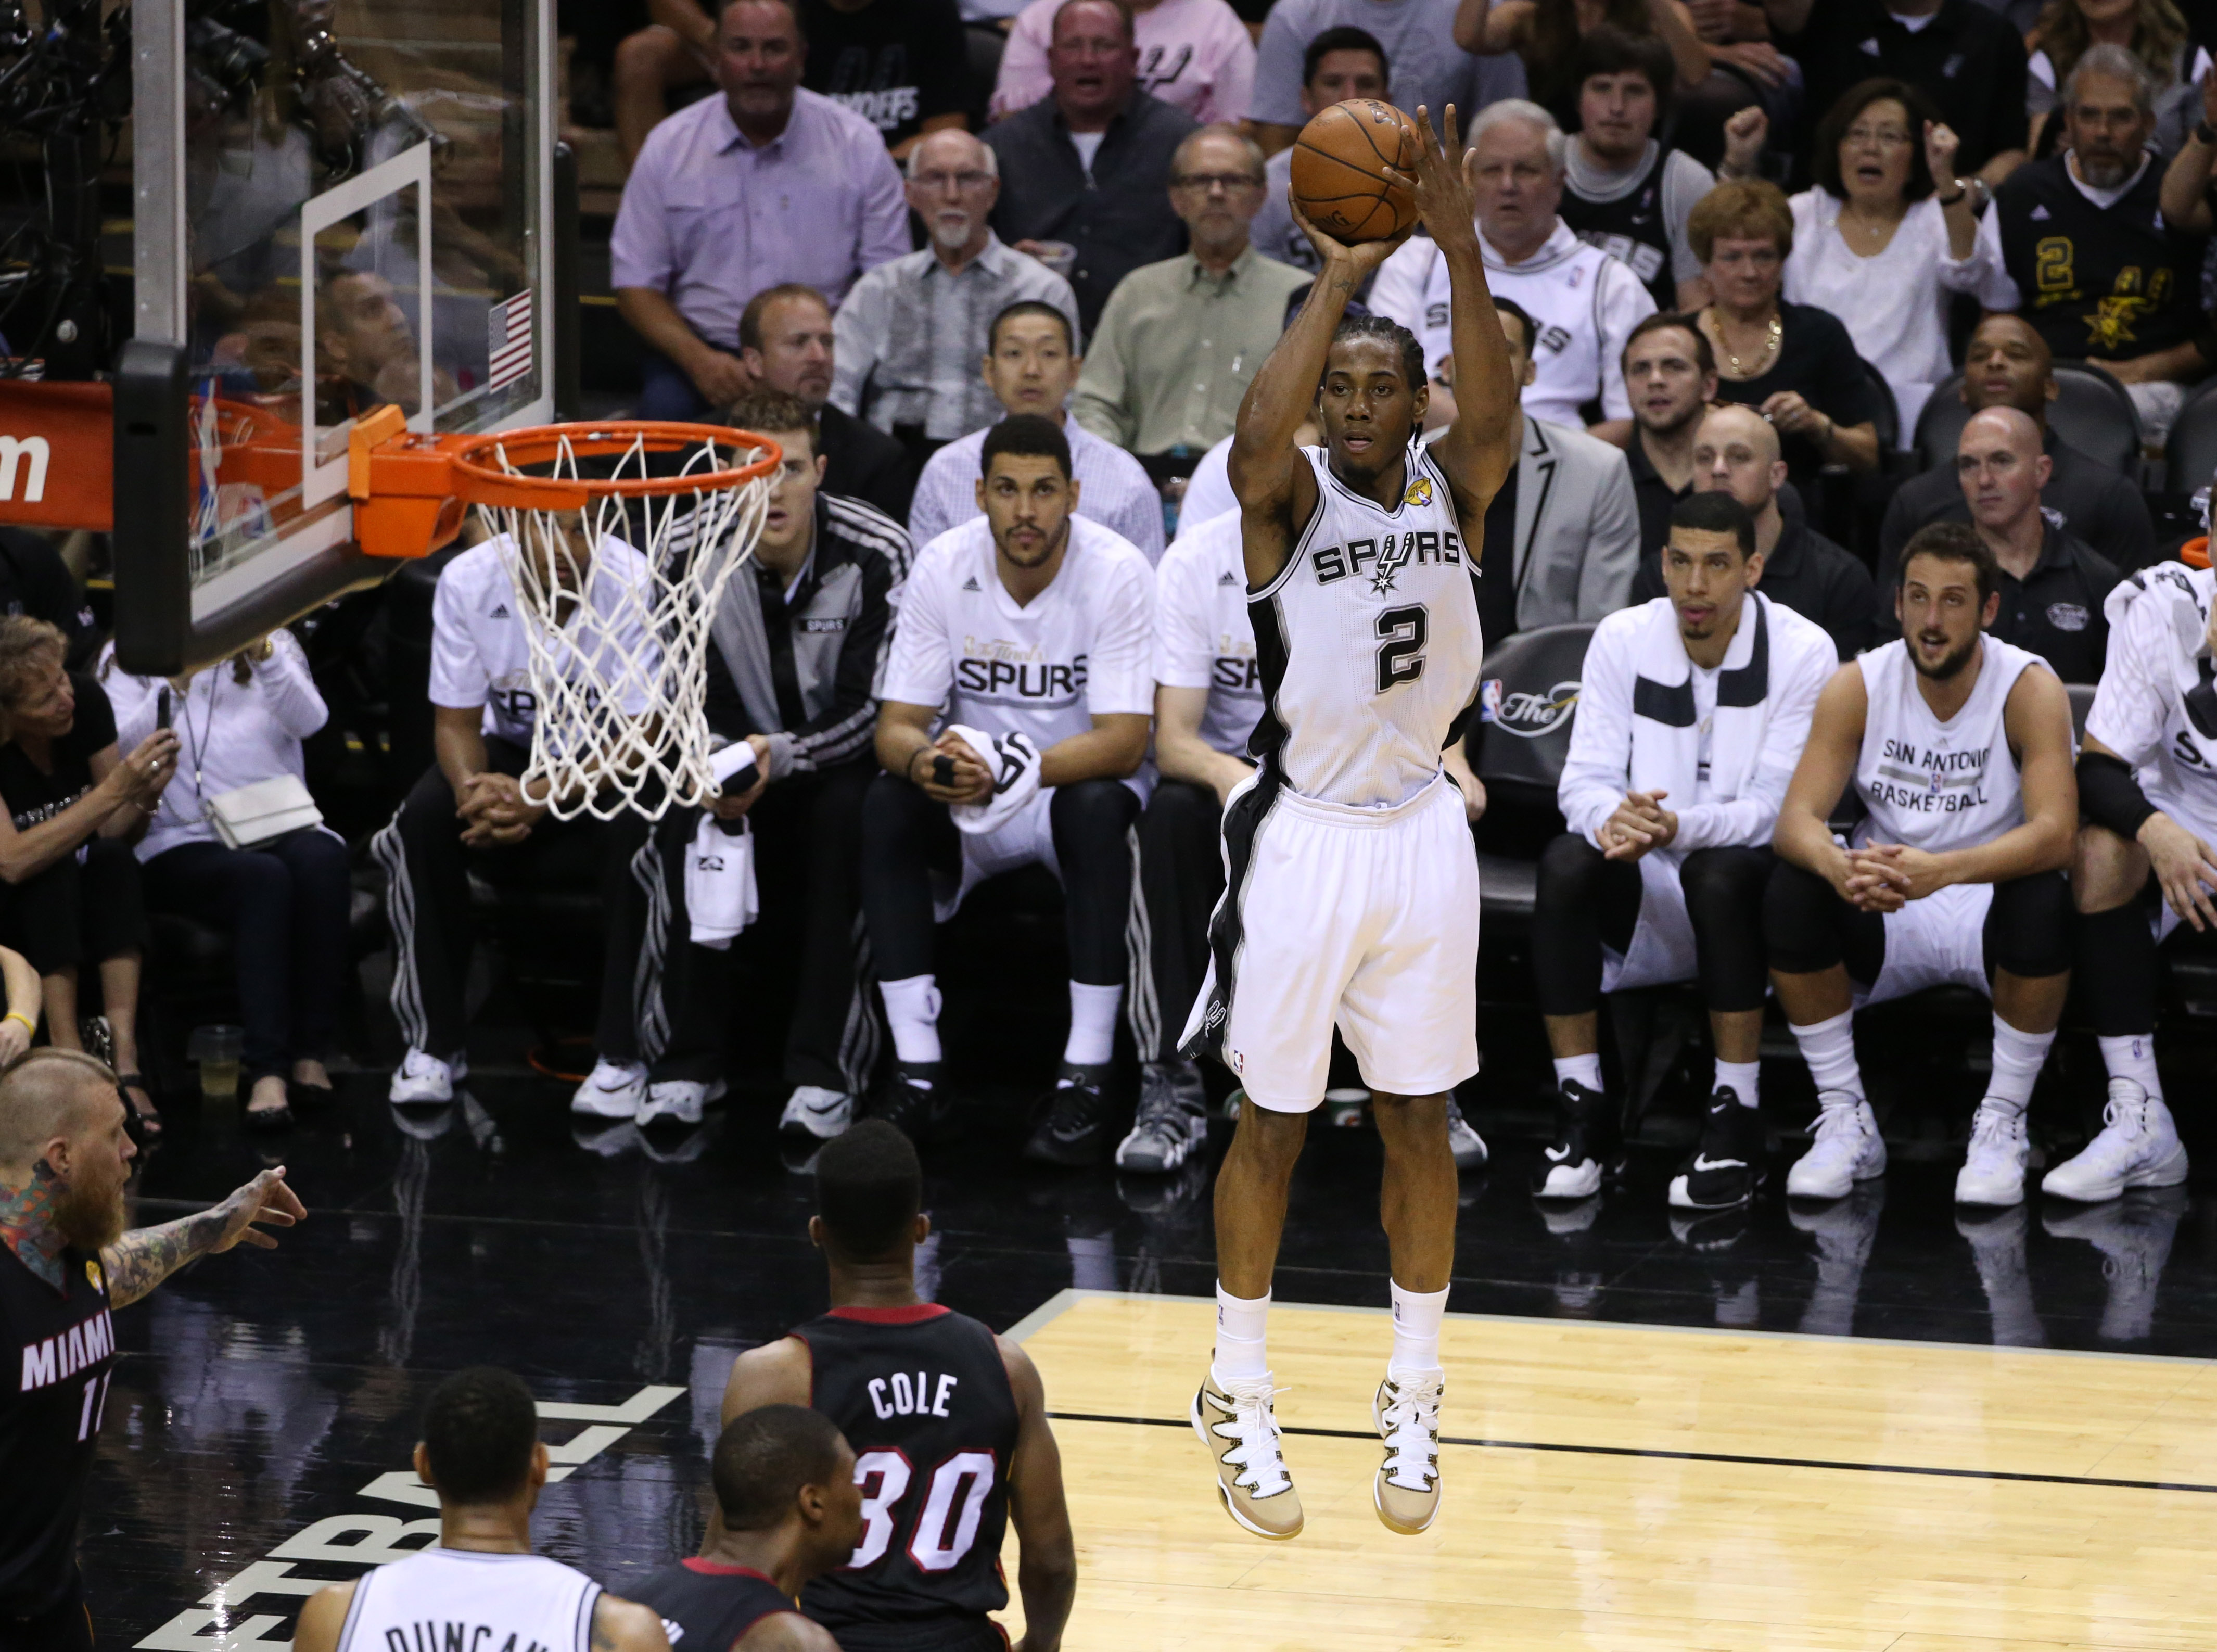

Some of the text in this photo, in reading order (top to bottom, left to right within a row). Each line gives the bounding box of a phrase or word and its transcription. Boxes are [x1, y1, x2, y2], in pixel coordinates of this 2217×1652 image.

[2036, 236, 2074, 292] 2
[1310, 529, 1460, 589] SPURS
[958, 654, 1088, 697] SPURS
[1373, 602, 1429, 695] 2
[1884, 739, 1916, 764] SAN
[21, 1306, 115, 1392] MIAMI
[868, 1371, 958, 1420] COLE
[846, 1446, 998, 1572] 30
[385, 1619, 549, 1652] DUNCA
